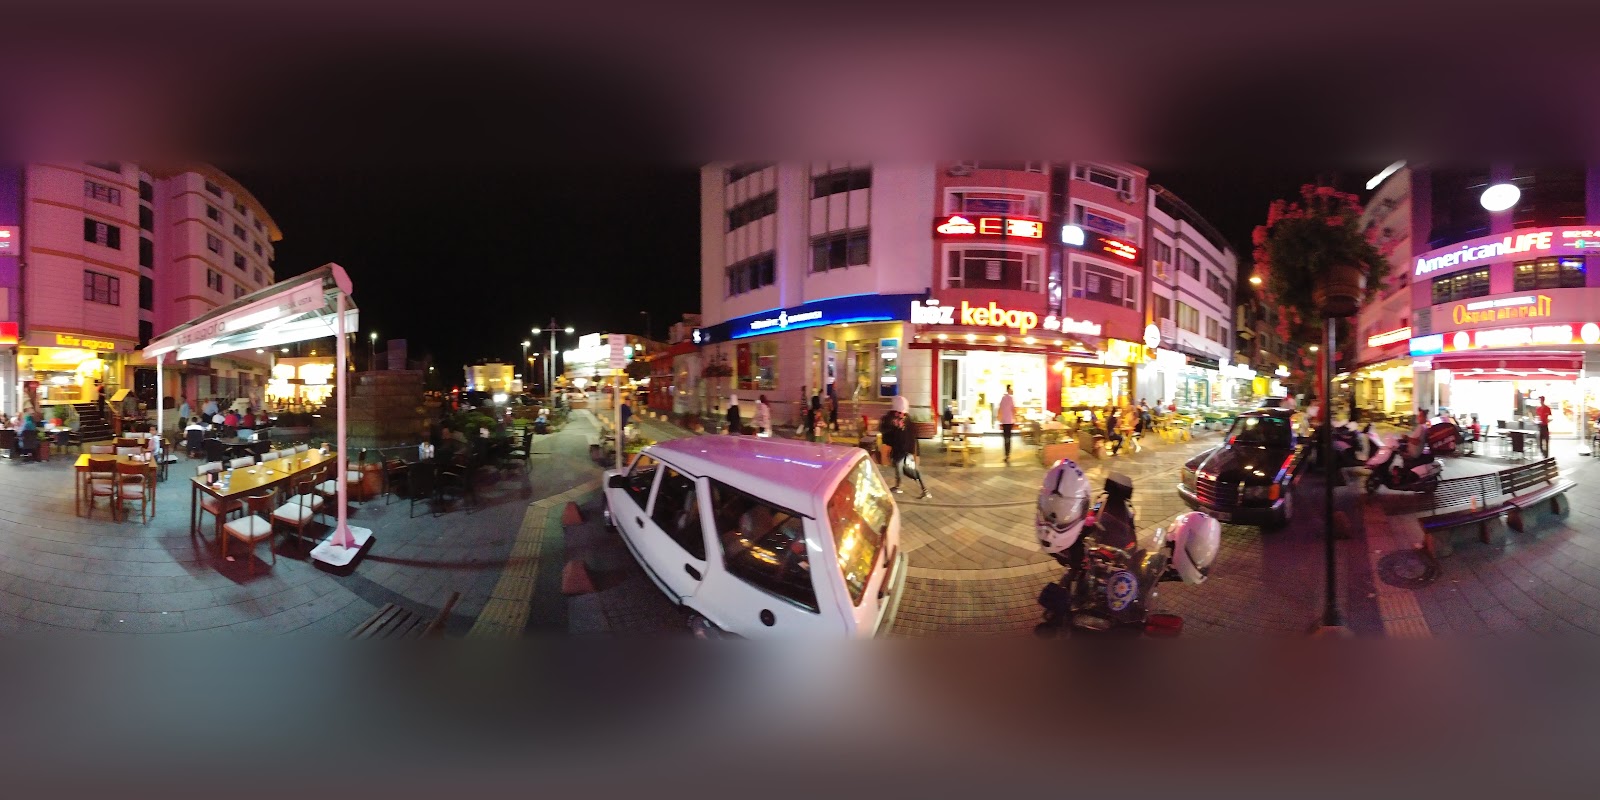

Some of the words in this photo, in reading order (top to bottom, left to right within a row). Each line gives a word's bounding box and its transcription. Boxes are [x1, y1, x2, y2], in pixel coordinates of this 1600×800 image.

[1415, 231, 1553, 276] AmericanLIFE
[910, 299, 954, 325] köz
[961, 300, 1038, 335] kebap
